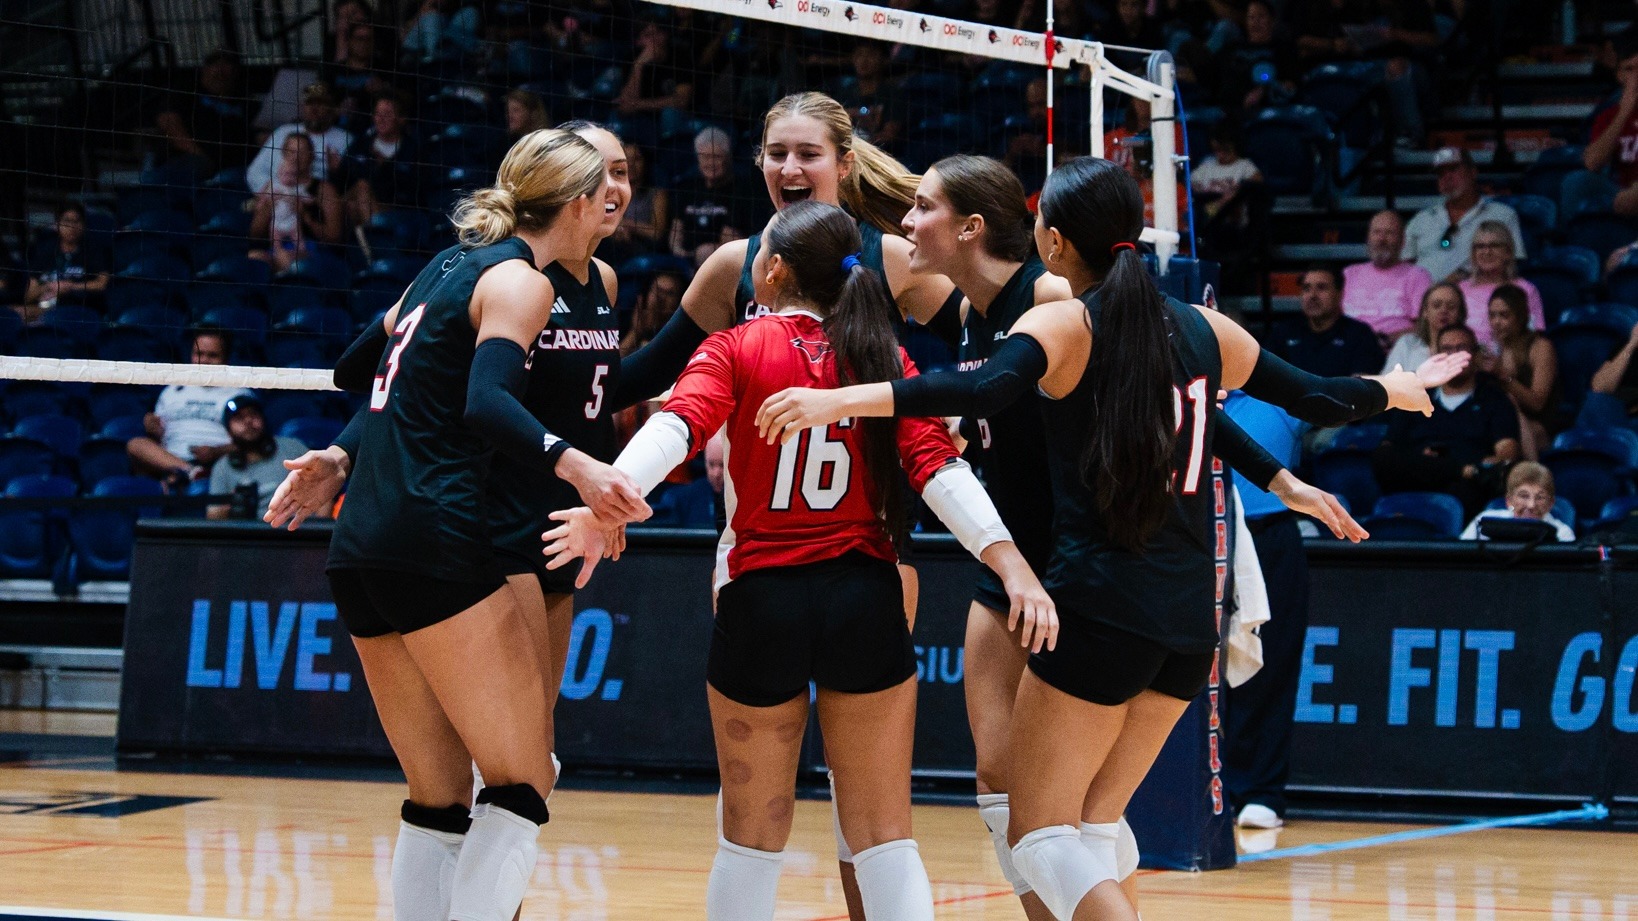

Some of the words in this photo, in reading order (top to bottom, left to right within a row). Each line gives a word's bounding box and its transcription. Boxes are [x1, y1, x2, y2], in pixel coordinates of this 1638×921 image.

[811, 2, 831, 17] Energy
[370, 303, 426, 412] 3
[537, 328, 620, 351] CARDINA
[584, 364, 610, 421] 5
[1166, 374, 1208, 495] 1
[769, 416, 852, 512] 16
[185, 598, 352, 692] LIVE.
[1387, 627, 1521, 730] FIT.
